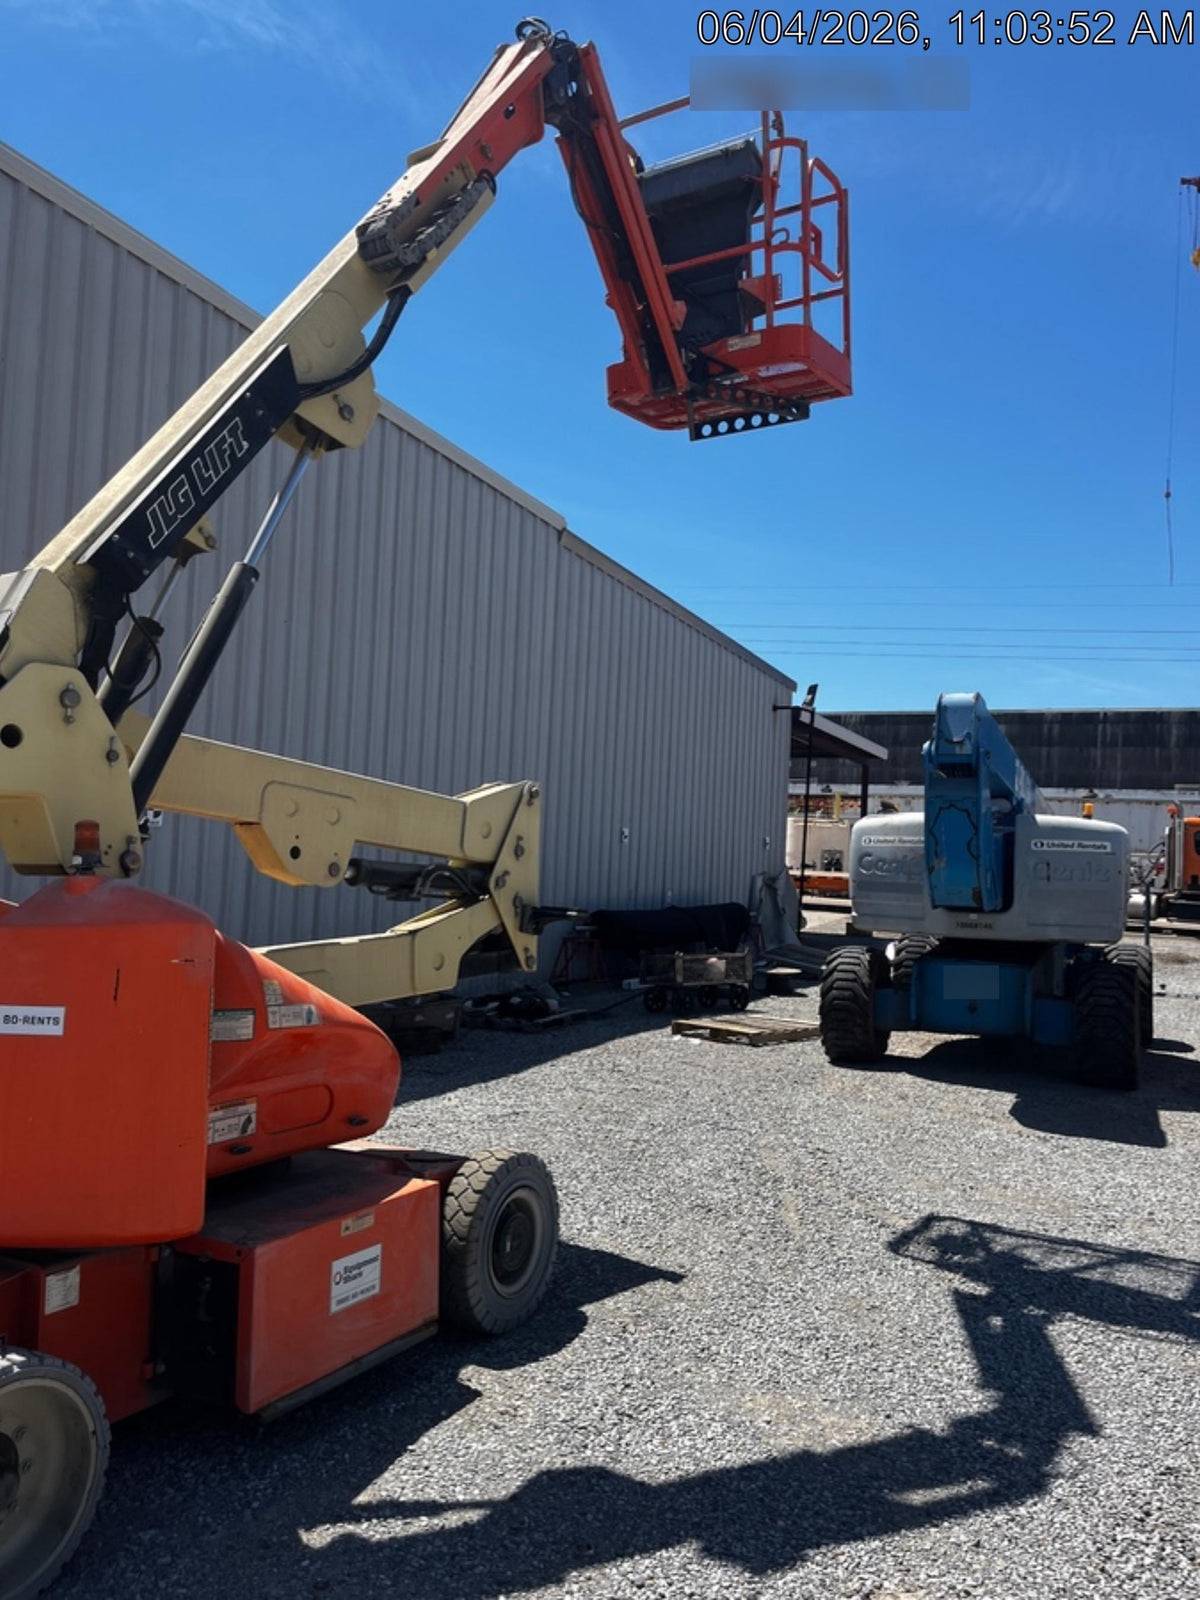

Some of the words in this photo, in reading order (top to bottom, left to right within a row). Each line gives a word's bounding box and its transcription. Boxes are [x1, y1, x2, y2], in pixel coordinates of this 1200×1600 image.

[146, 473, 197, 550] JLG
[191, 416, 250, 497] LIFT
[1047, 841, 1076, 850] United
[1077, 841, 1109, 852] Rentals
